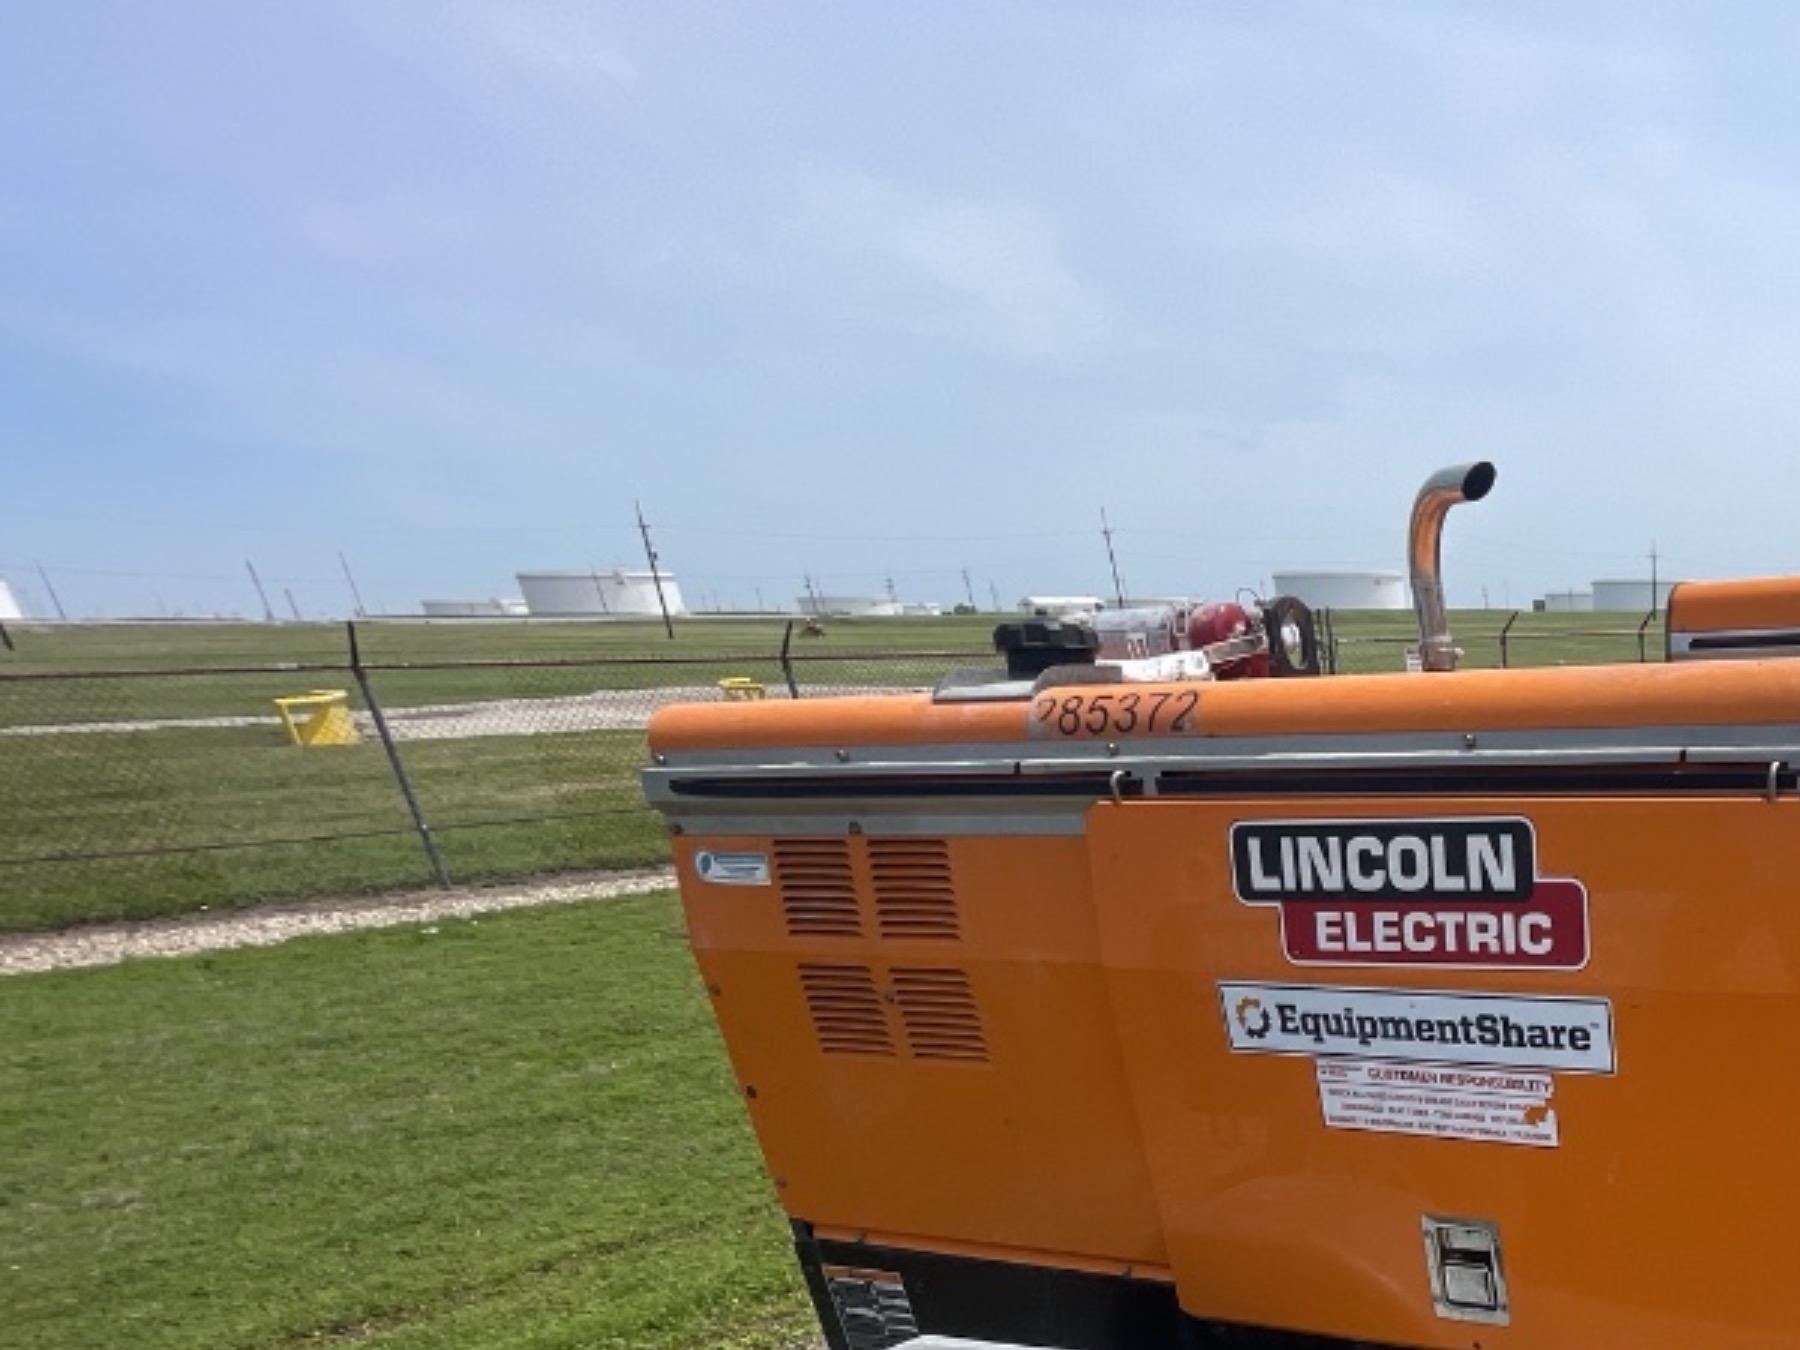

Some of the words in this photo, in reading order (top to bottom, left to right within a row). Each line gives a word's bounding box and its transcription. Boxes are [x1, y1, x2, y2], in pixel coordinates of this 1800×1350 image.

[1037, 690, 1199, 736] 285372
[1247, 833, 1517, 893] LINCOLN
[1314, 911, 1554, 955] ELECTRIC
[1275, 1003, 1592, 1052] EquipmentShare
